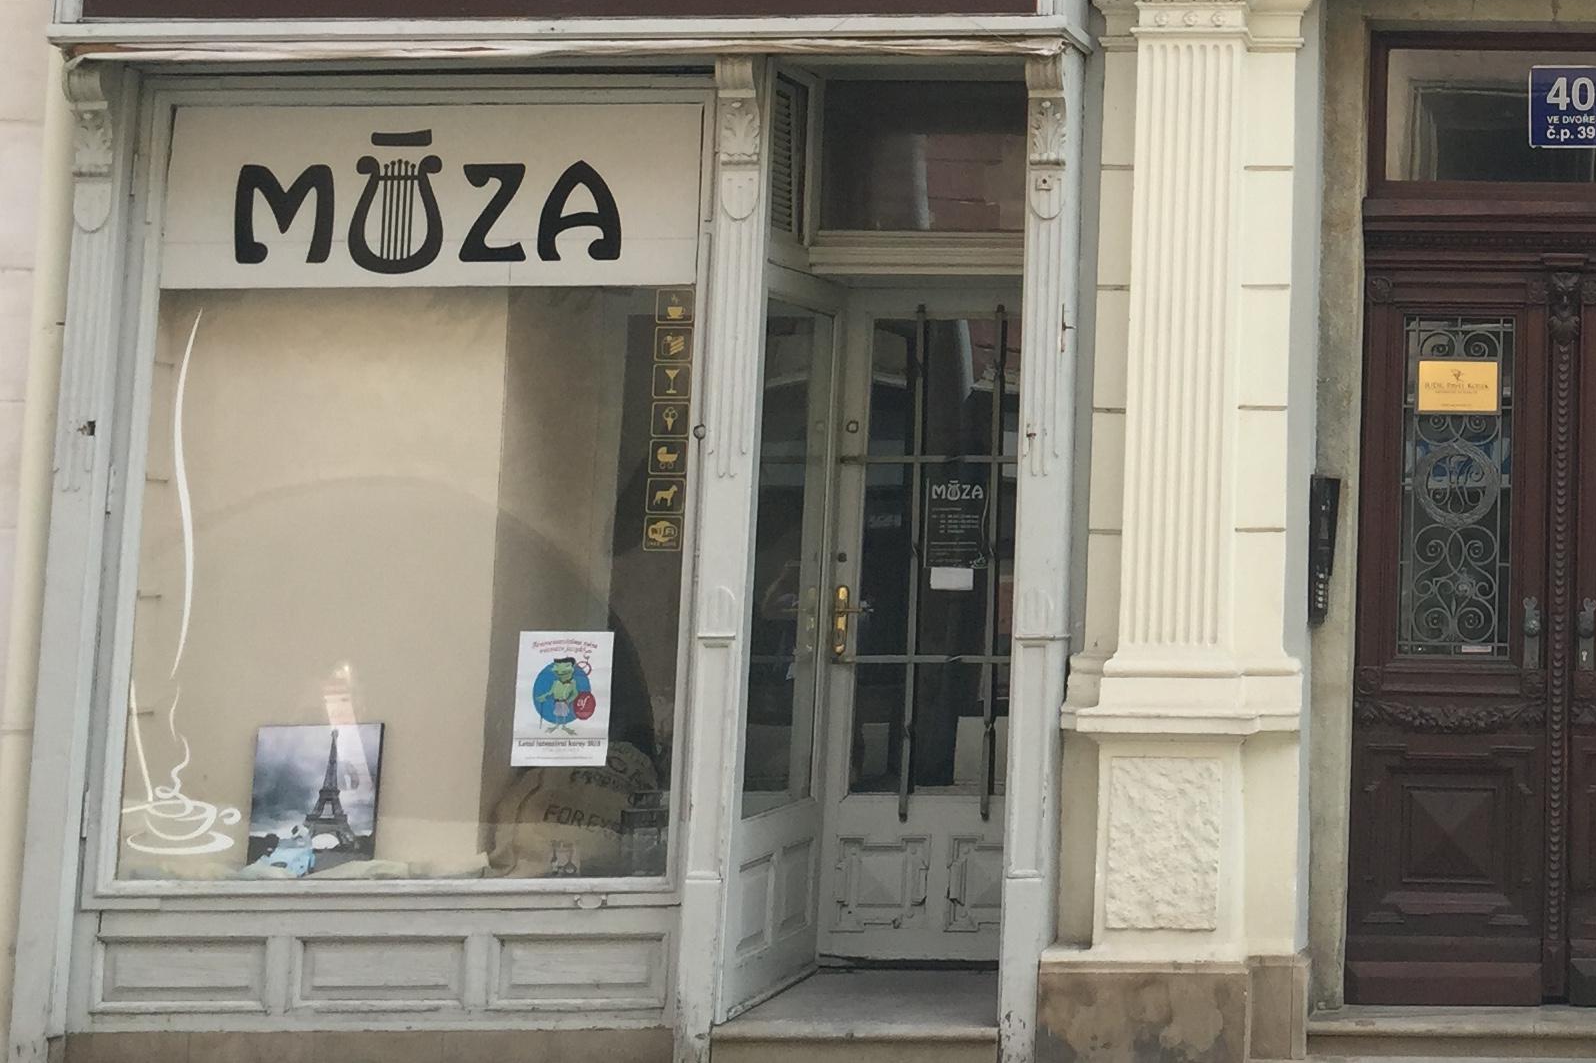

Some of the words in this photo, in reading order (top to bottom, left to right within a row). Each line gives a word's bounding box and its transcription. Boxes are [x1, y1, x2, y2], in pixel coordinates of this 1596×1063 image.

[1546, 76, 1596, 112] 40
[1546, 115, 1560, 124] VE
[1546, 125, 1575, 142] č.p.
[1577, 125, 1596, 139] 39
